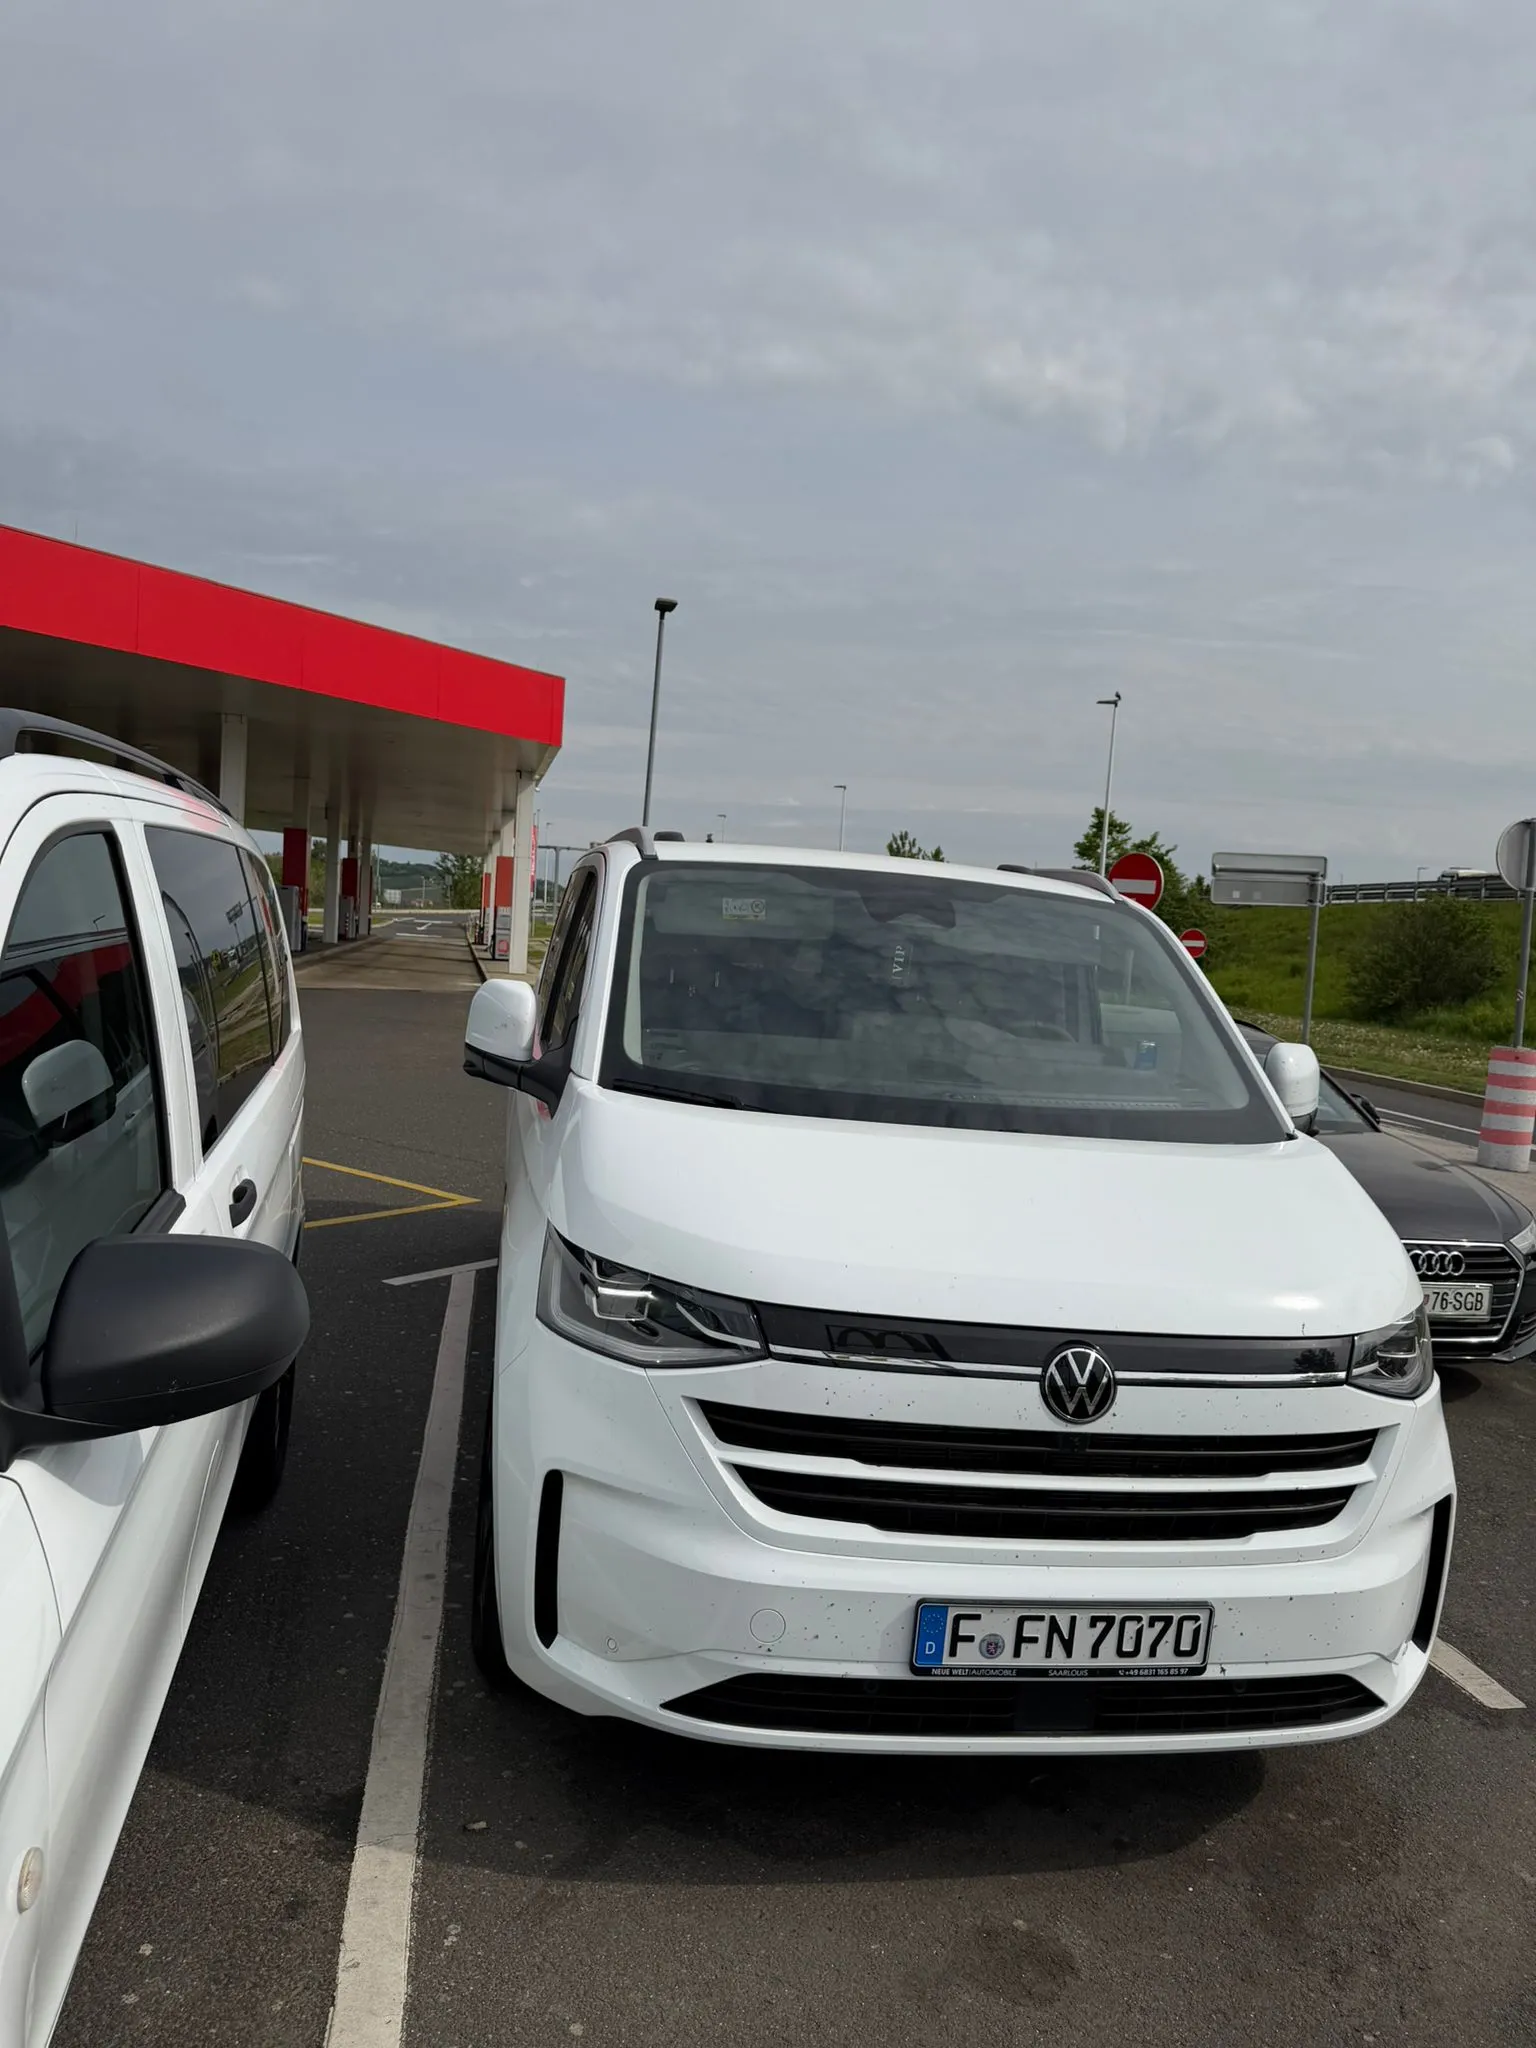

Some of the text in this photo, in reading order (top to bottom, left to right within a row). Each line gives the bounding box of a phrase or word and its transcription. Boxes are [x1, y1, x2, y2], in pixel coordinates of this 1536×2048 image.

[1431, 1291, 1484, 1311] 76-SGB
[948, 1613, 982, 1657] F
[1089, 1615, 1201, 1658] 7070
[924, 1641, 936, 1655] D
[931, 1668, 950, 1676] NEUE
[1048, 1669, 1089, 1677] SAARLOUIS
